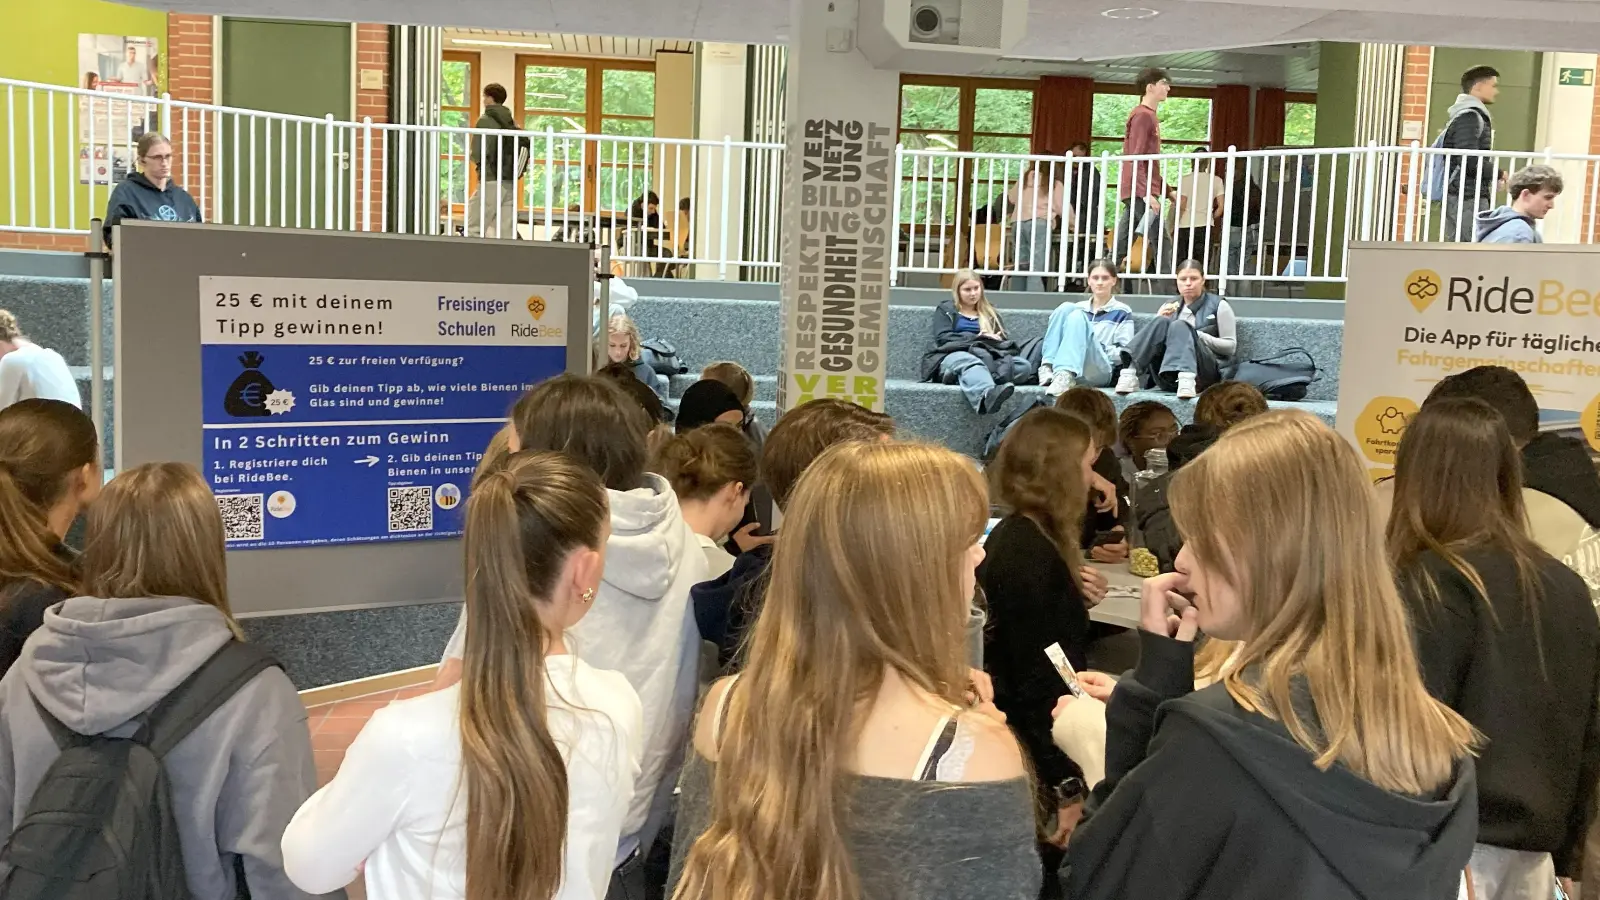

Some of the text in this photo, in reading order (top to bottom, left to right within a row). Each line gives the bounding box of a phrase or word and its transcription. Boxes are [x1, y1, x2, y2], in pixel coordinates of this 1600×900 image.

[803, 119, 824, 182] VER
[824, 119, 844, 182] NETZ
[842, 120, 864, 182] UNG
[802, 185, 862, 208] BILD
[800, 210, 862, 234] UNG
[856, 122, 890, 373] GEMEINSCHAFT
[216, 293, 392, 309] 25 € mit deinem
[438, 295, 510, 314] Freisinger
[796, 234, 820, 370] RESPEKT
[820, 235, 858, 372] GESUNDHEIT
[1447, 275, 1600, 317] RideBe
[216, 319, 382, 338] Tipp gewinnen!
[438, 320, 496, 337] Schulen
[511, 323, 564, 338] RideBee
[1405, 327, 1437, 343] Die
[1441, 329, 1481, 349] App
[1486, 331, 1517, 347] für
[309, 357, 322, 365] 25
[361, 356, 395, 364] freien
[400, 356, 463, 366] Verfügung?
[1397, 349, 1600, 377] Fahrgemeinschafte
[310, 384, 328, 393] Gib
[333, 383, 374, 393] deinen
[378, 384, 403, 394] Tipp
[407, 384, 423, 393] ab,
[450, 383, 477, 391] viele
[481, 383, 517, 391] Bienen
[793, 374, 878, 394] VER
[310, 397, 443, 408] Glas sind und gewinne!
[215, 431, 448, 449] In 2 Schritten zum Gewinn
[214, 457, 327, 470] 1. Registriere dich
[388, 455, 397, 463] 2.
[402, 454, 420, 462] Gib
[425, 453, 461, 461] deinen
[215, 473, 292, 483] bei RideBee.
[388, 468, 426, 476] Bienen
[445, 466, 476, 476] unser
